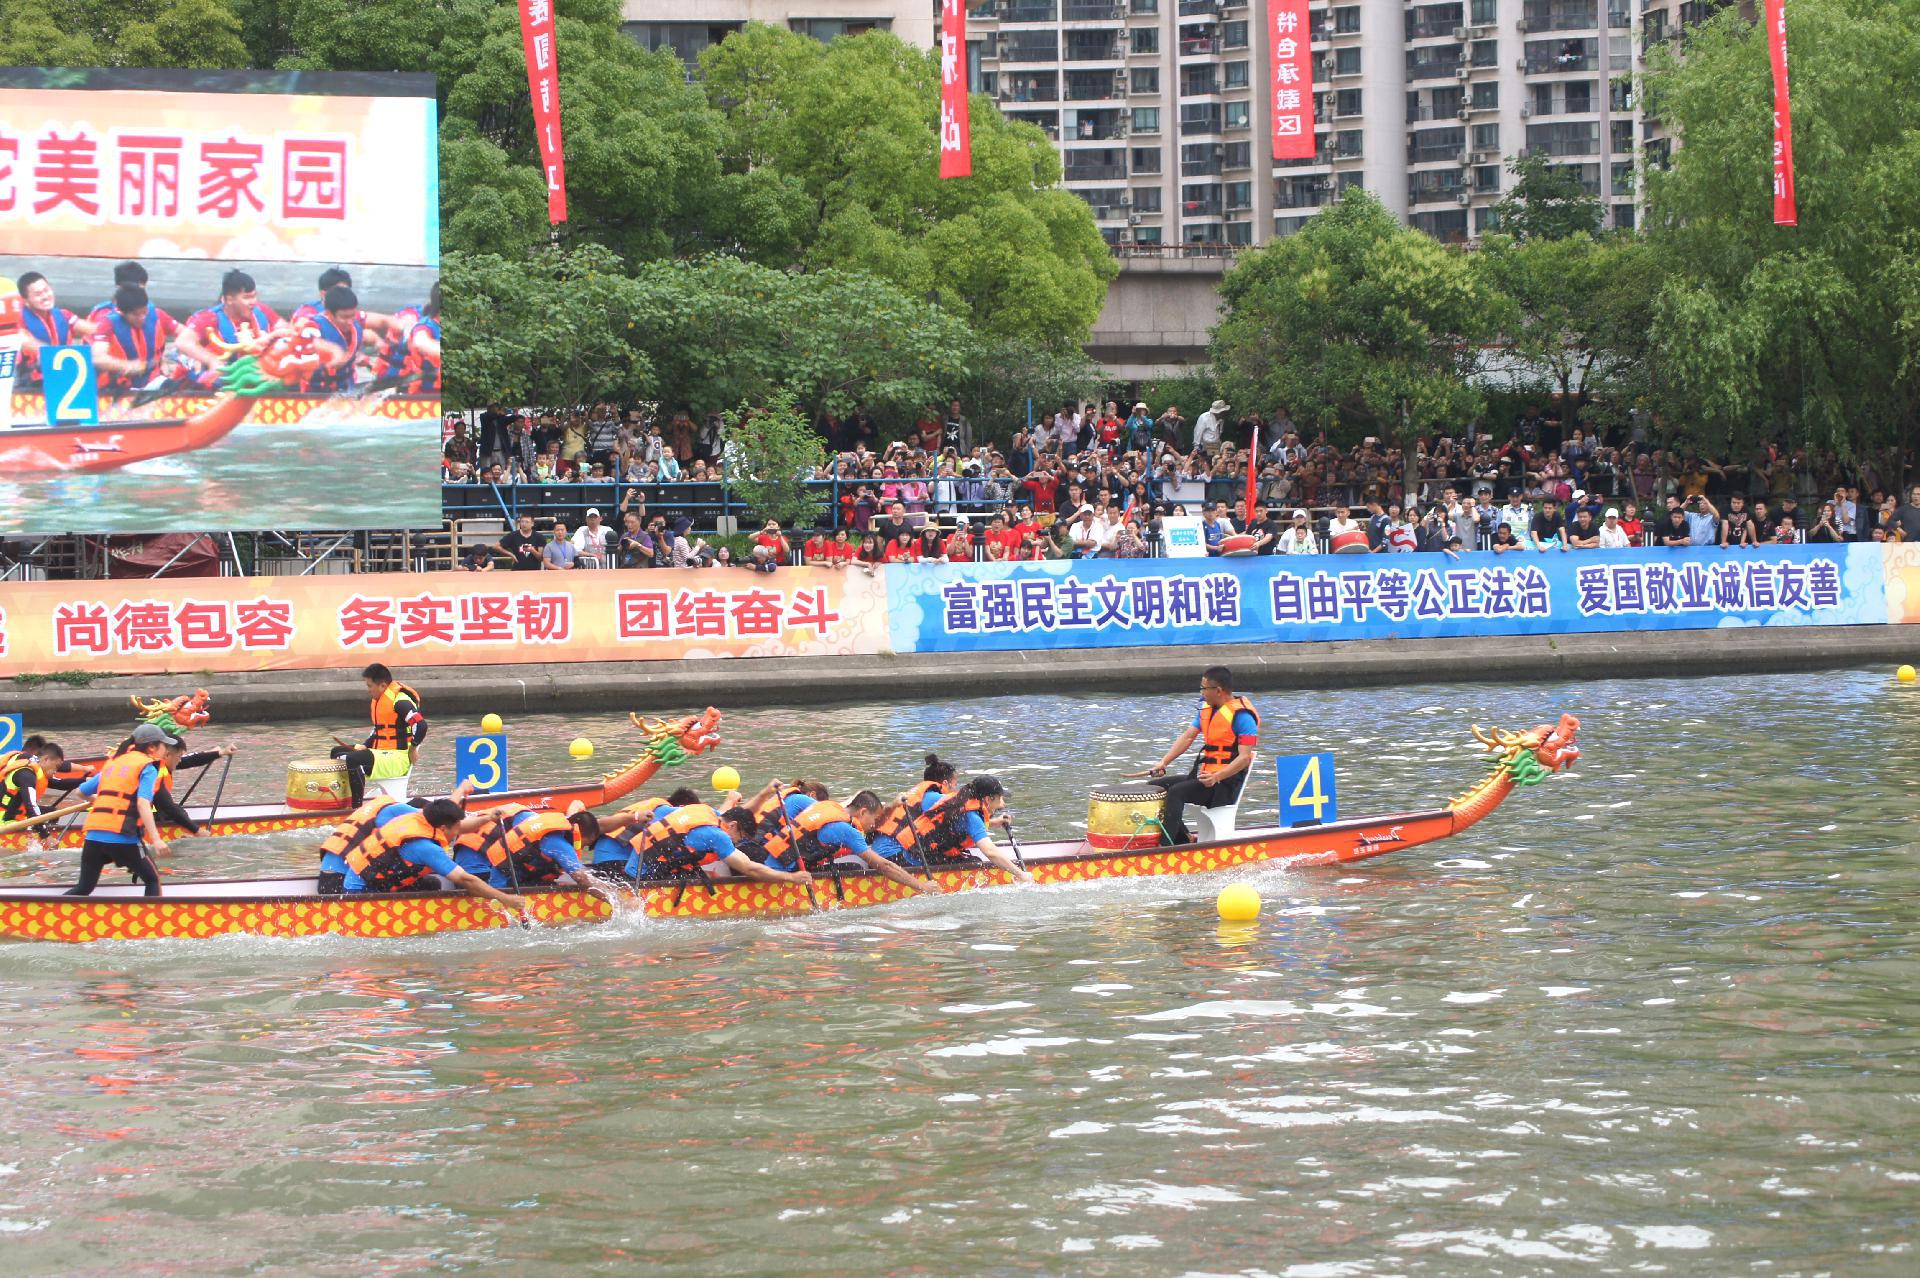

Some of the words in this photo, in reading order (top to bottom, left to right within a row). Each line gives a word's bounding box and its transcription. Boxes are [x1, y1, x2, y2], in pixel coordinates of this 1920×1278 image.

[53, 348, 92, 420] 2
[57, 601, 293, 652] 尚德包容
[342, 595, 571, 644] 务实坚韧
[619, 589, 838, 637] 团结奋斗
[943, 573, 1239, 632] 富强民主文明和谐
[1273, 567, 1548, 621] 自由平等公正法治
[1579, 560, 1840, 613] 爱国敬业诚信友善
[468, 738, 501, 789] 3
[1289, 756, 1329, 818] 4
